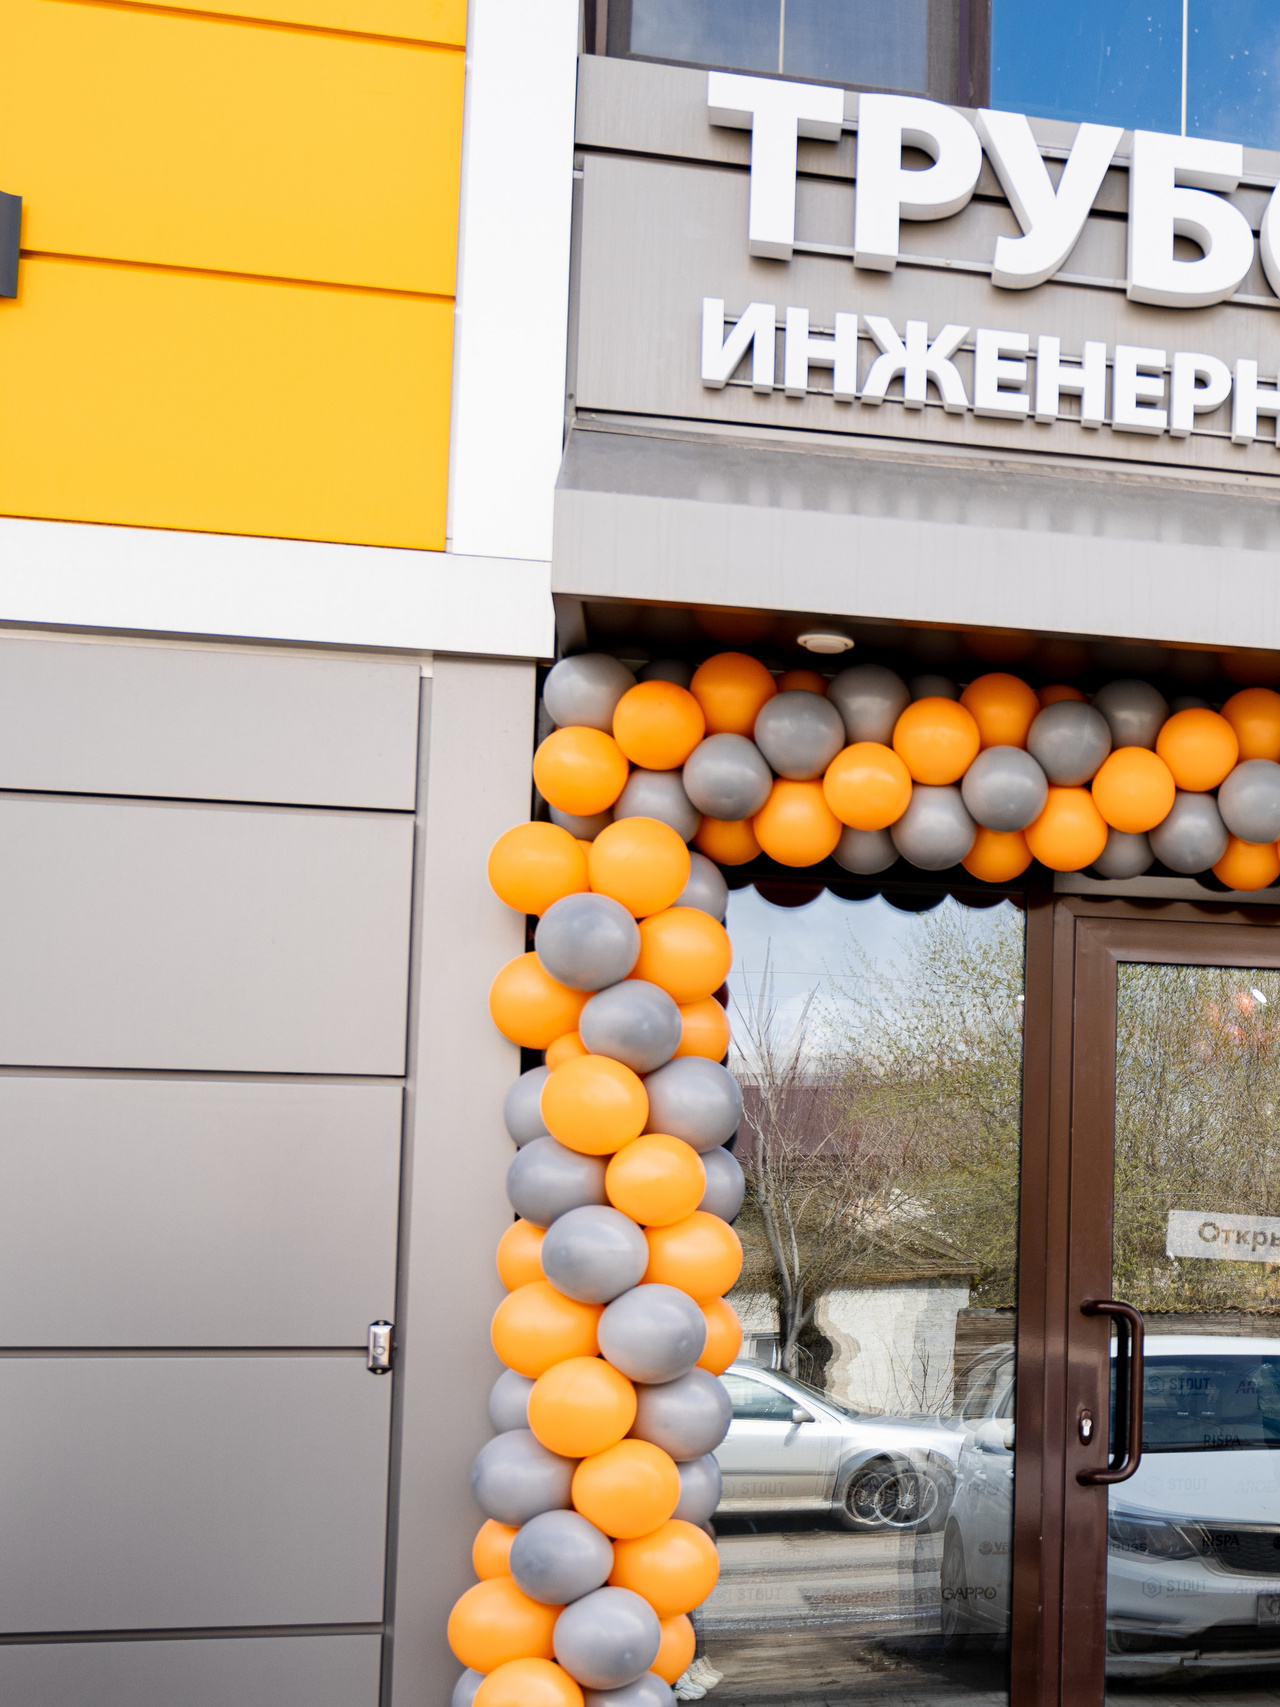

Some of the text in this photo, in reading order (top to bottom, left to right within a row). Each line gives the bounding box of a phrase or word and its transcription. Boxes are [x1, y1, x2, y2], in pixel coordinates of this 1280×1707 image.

[1169, 1378, 1210, 1390] STOUT
[1204, 1434, 1240, 1446] RISPA
[741, 1482, 786, 1494] STOUT
[1168, 1478, 1209, 1490] STOUT
[1202, 1534, 1240, 1547] RISPA
[1167, 1580, 1208, 1592] STOUT
[941, 1586, 998, 1600] GAPPO
